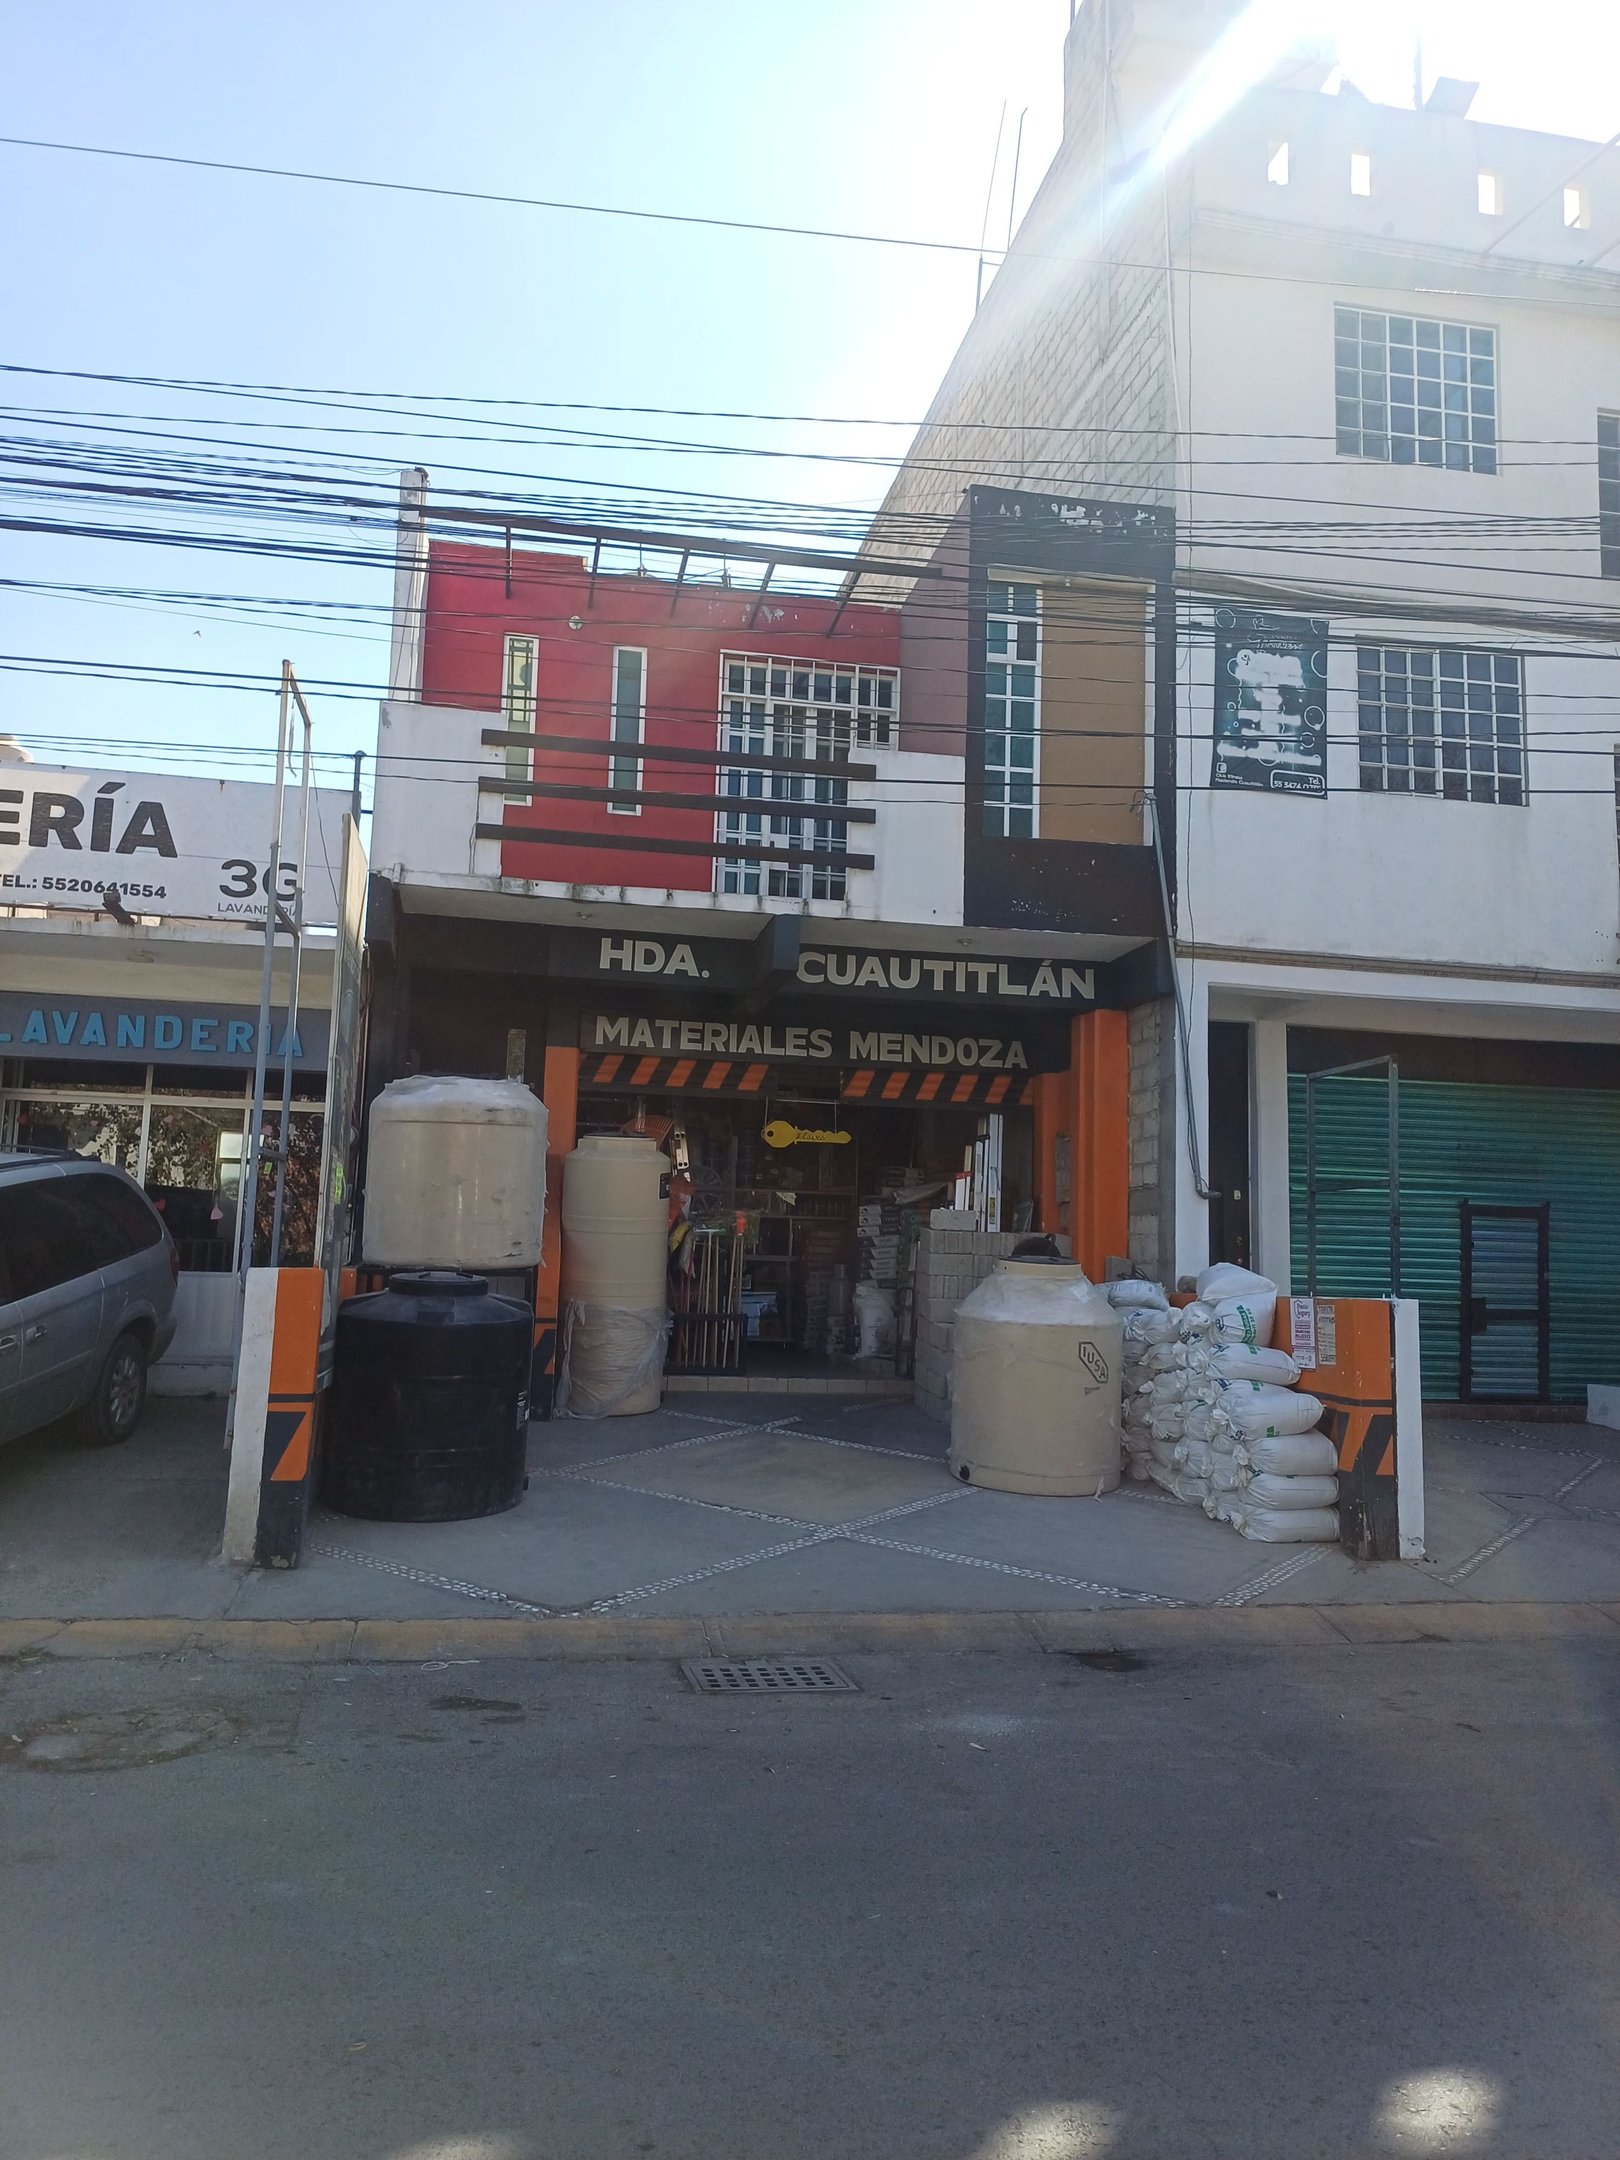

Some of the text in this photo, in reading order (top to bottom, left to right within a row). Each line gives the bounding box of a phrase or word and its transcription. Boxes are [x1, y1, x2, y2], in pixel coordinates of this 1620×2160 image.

[0, 873, 37, 889] EL.:
[219, 859, 299, 902] 3G
[598, 936, 1095, 1000] HDA. CUAUTITLÁN
[594, 1015, 1029, 1070] MATERIALES MENDOZA
[1082, 1345, 1106, 1379] IUSA
